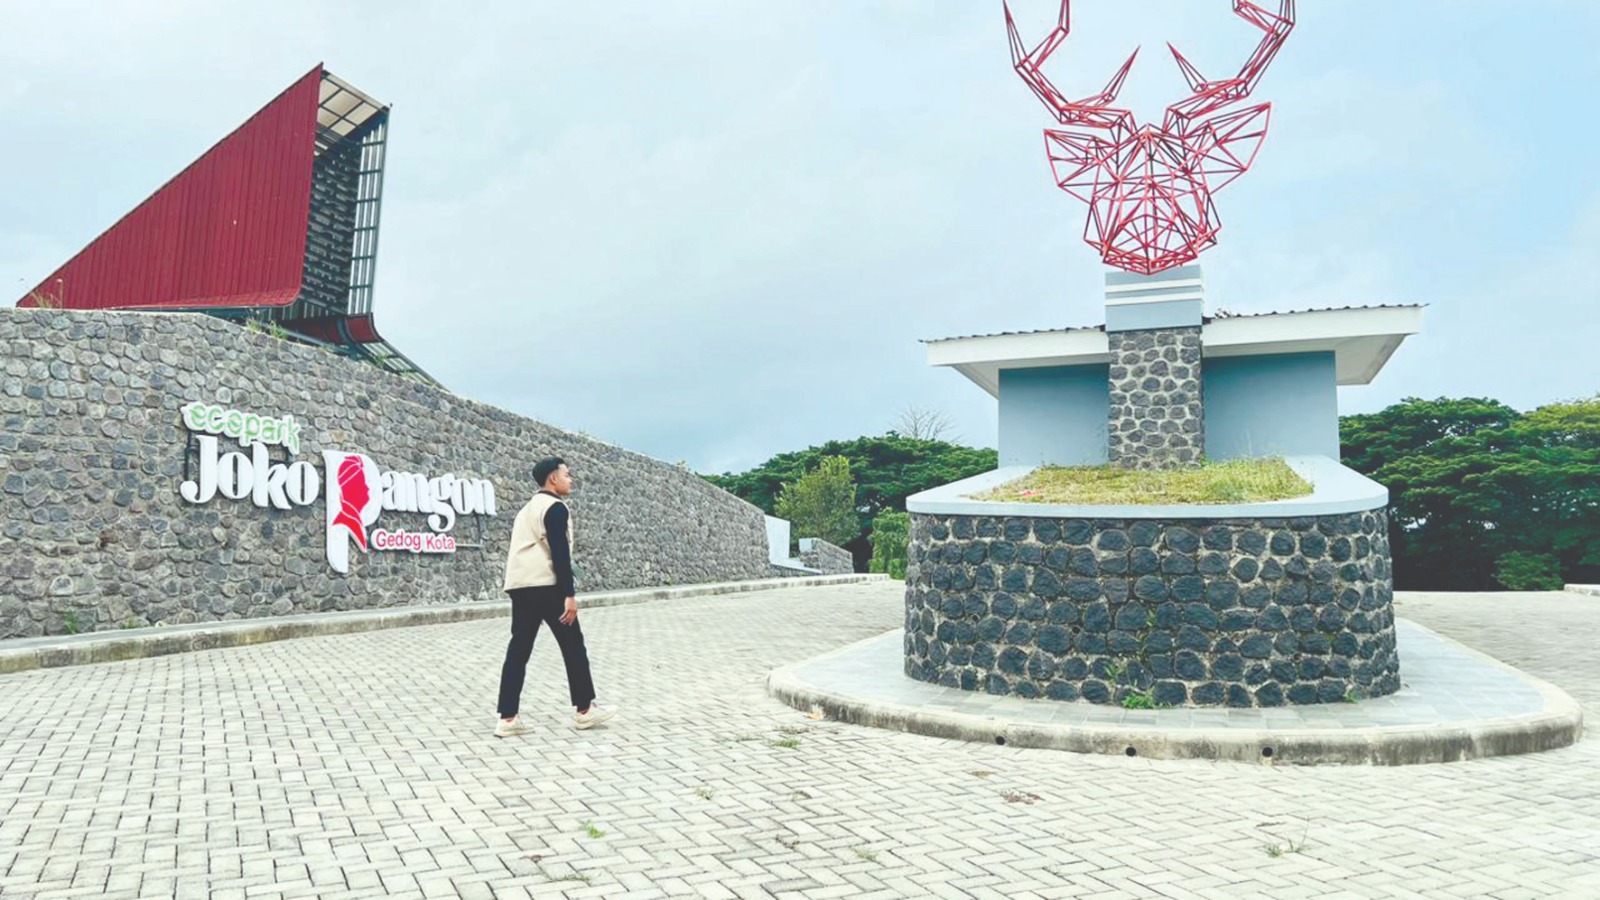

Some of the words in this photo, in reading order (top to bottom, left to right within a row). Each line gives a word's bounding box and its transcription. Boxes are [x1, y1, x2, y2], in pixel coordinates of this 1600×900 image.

[184, 403, 300, 453] ecopark
[180, 434, 319, 510] Joko
[322, 450, 497, 573] Pangon
[375, 531, 421, 550] Gedog
[426, 536, 455, 551] Kota
